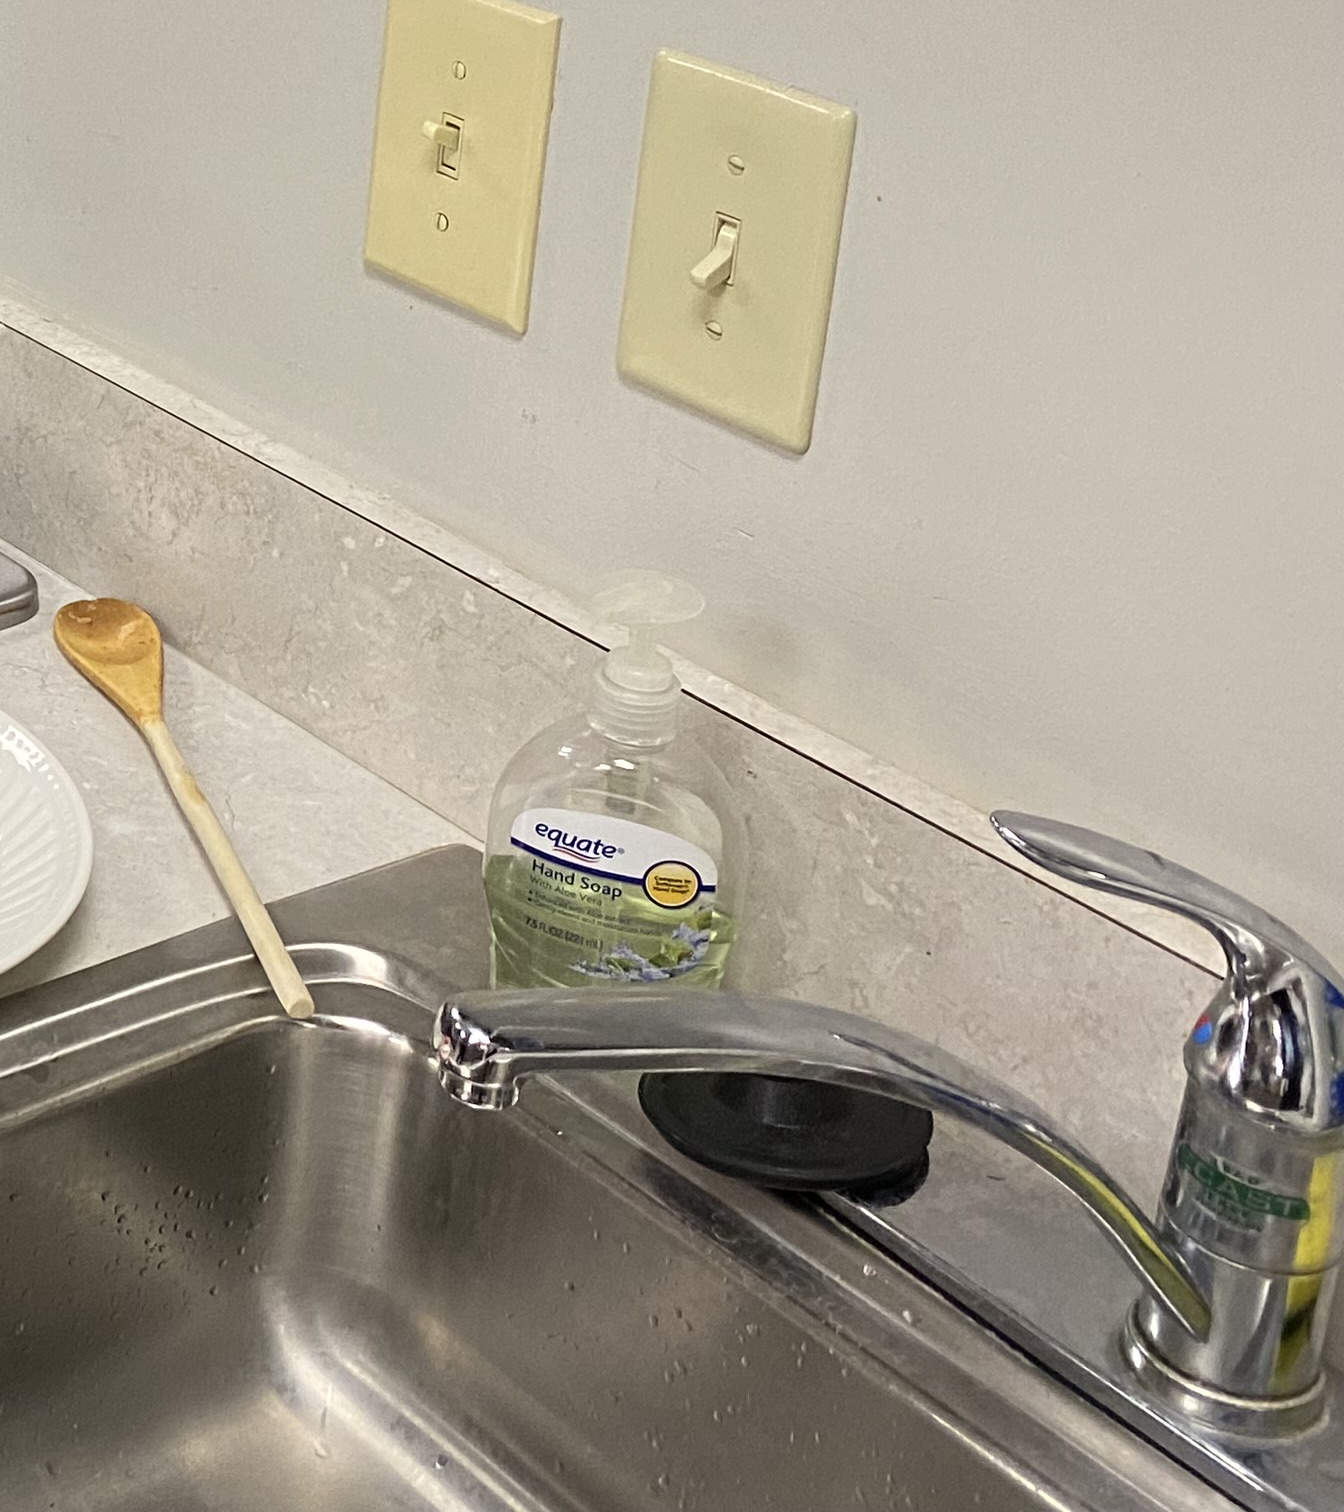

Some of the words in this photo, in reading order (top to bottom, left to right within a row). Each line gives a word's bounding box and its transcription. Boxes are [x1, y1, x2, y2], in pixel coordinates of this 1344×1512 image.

[535, 823, 618, 858] equate
[529, 874, 553, 890] With
[555, 886, 577, 900] Aloe
[579, 892, 603, 907] Vera
[532, 859, 575, 886] Hand
[580, 876, 622, 901] Soap
